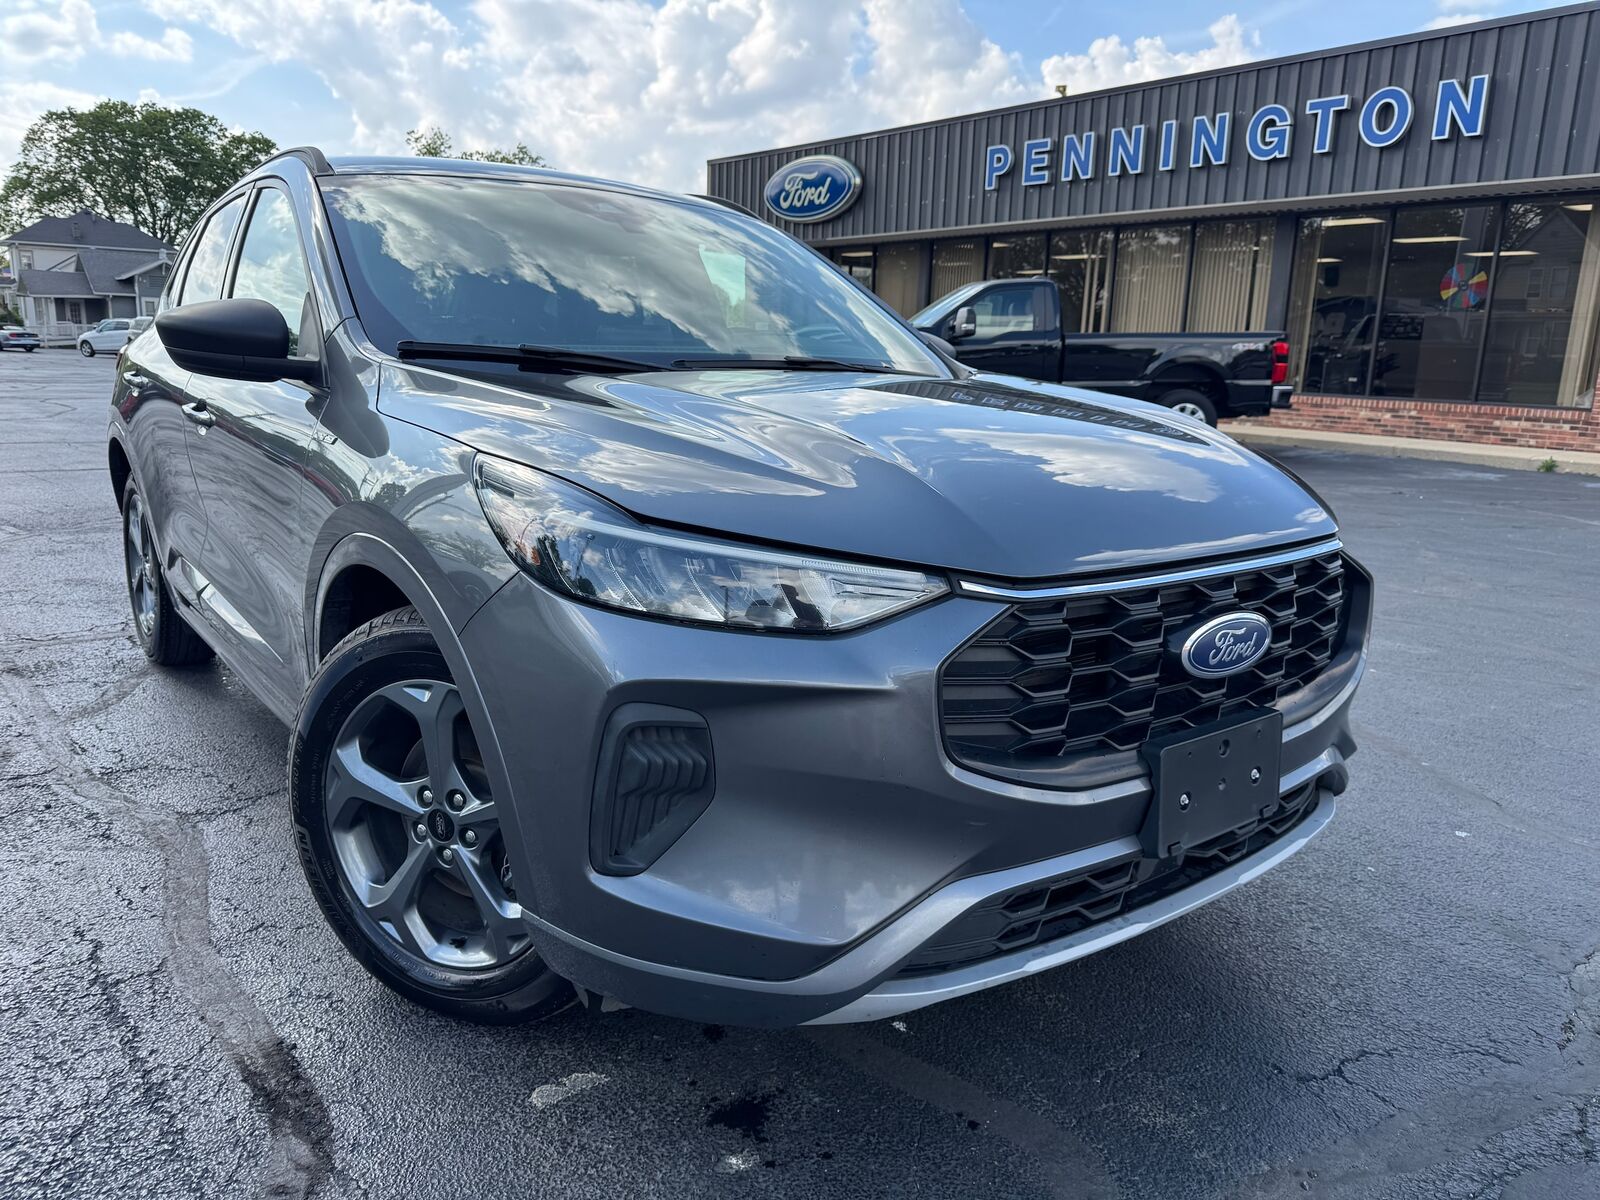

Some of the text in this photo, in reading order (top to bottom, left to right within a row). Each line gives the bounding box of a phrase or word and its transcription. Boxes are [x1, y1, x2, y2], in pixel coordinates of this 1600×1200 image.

[984, 74, 1491, 191] PENNINGTON
[780, 171, 831, 209] Ford
[1208, 627, 1258, 665] Ford
